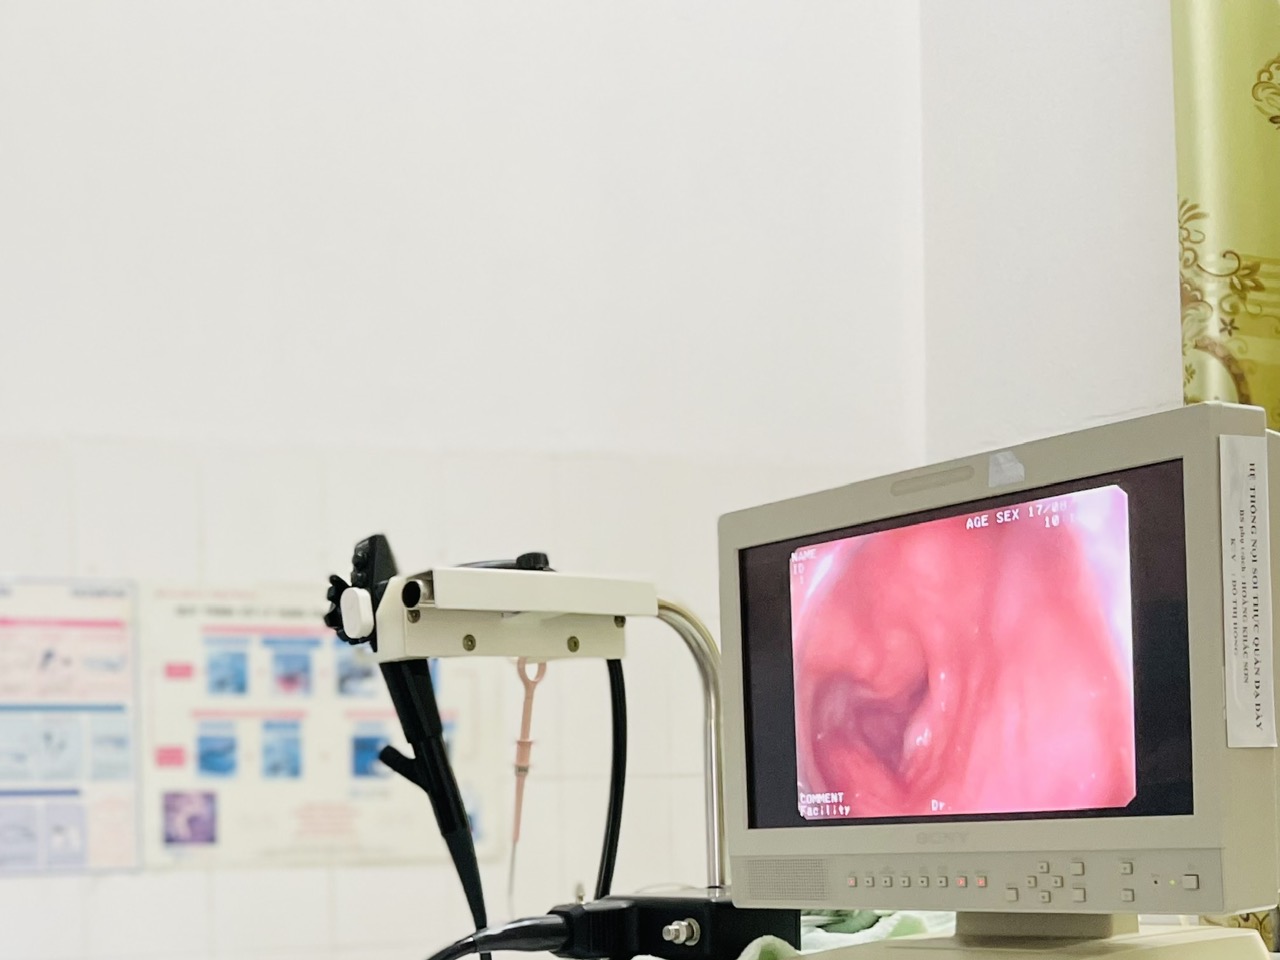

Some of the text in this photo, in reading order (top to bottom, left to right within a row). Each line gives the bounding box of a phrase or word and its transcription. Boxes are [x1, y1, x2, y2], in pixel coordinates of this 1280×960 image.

[965, 514, 989, 530] AGE
[996, 509, 1020, 523] SEX
[791, 548, 817, 562] NAME
[799, 792, 844, 805] COMMENT
[800, 804, 851, 817] Facility
